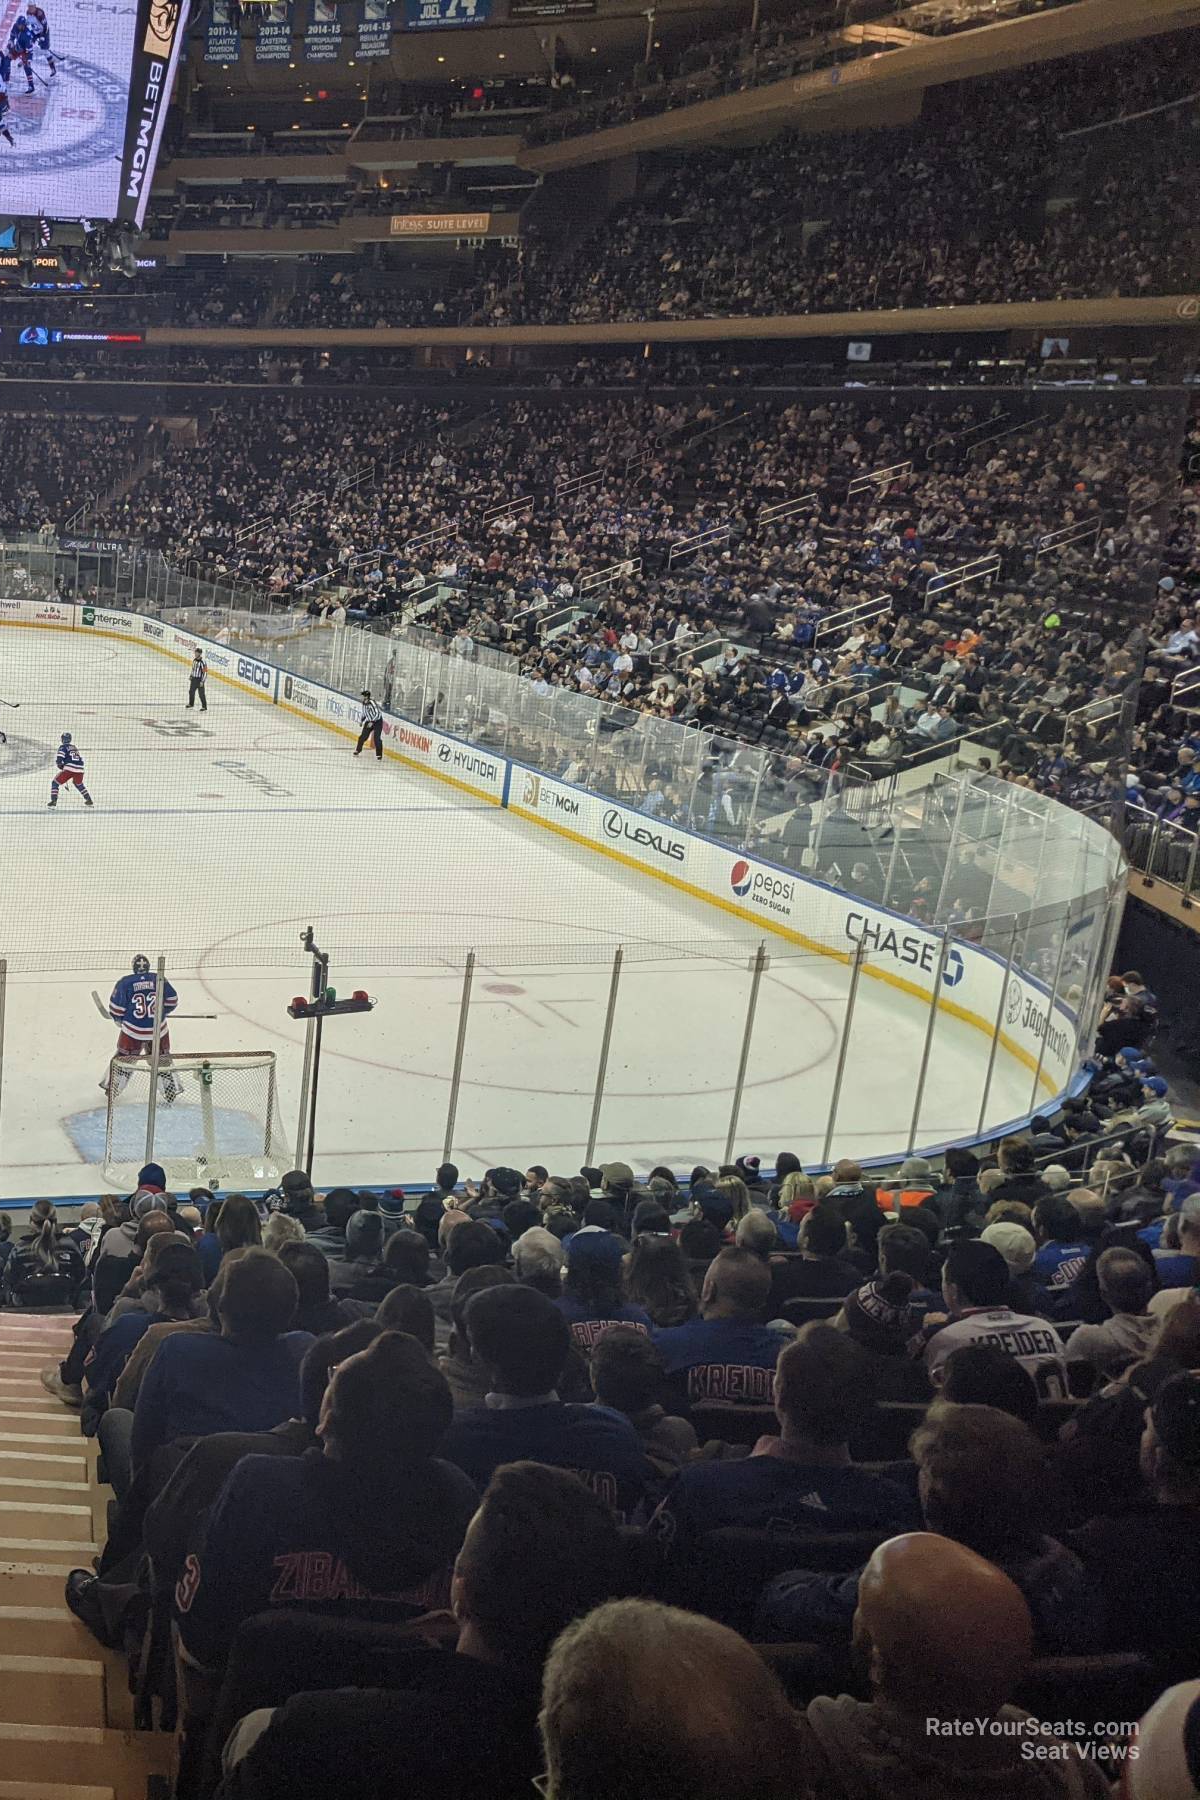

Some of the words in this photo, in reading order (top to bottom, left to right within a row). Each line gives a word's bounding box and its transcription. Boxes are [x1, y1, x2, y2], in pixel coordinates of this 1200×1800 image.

[259, 26, 290, 35] 2013-14
[307, 25, 341, 35] 2014-15
[358, 22, 391, 33] 2014-15
[127, 61, 163, 198] BETMGM
[427, 219, 455, 229] SUITE
[456, 219, 485, 229] LEVEL
[97, 542, 123, 551] ULTRA
[86, 612, 132, 628] enterprise
[237, 658, 270, 688] GEICO
[401, 727, 432, 754] DUNKIN'
[453, 751, 498, 782] HYUNDAI
[539, 789, 579, 816] BETMGM
[624, 821, 685, 861] LEXUS
[753, 871, 794, 901] pepsi
[751, 893, 768, 908] ZERO
[768, 900, 791, 915] SUGAR
[845, 912, 937, 973] CHASE
[688, 1364, 777, 1401] KREID
